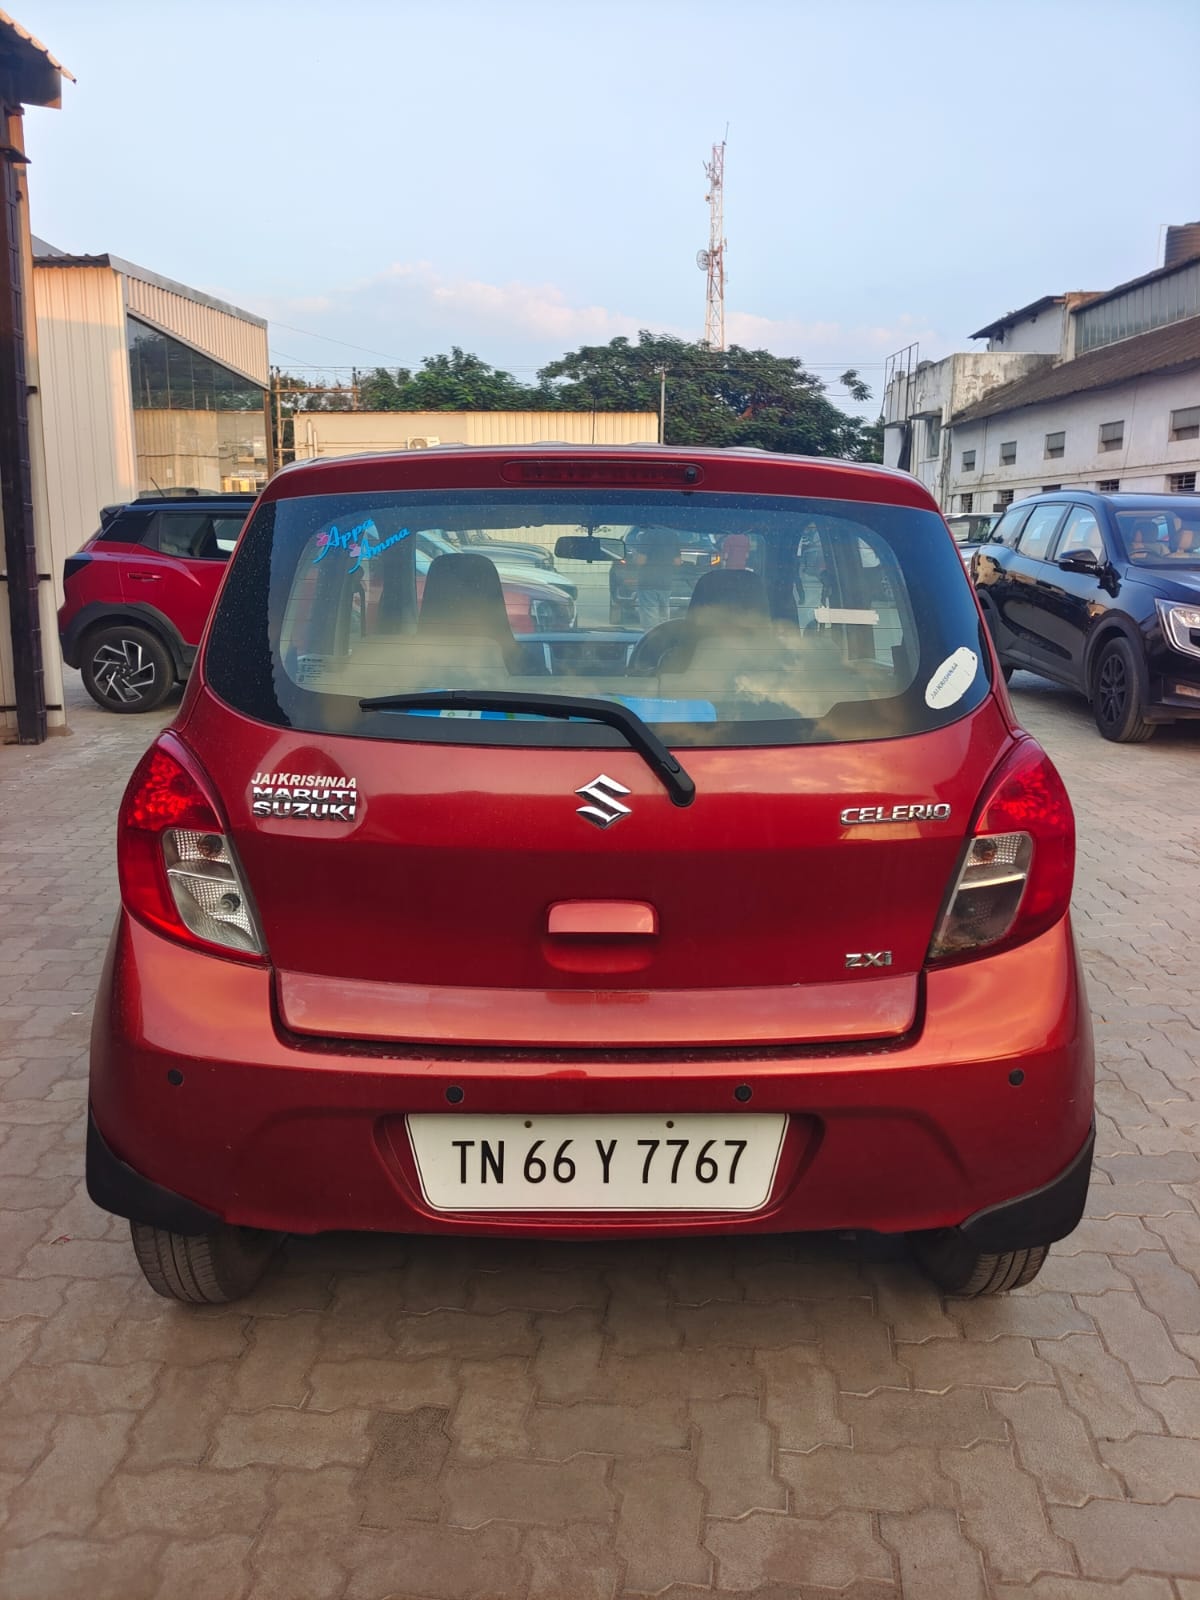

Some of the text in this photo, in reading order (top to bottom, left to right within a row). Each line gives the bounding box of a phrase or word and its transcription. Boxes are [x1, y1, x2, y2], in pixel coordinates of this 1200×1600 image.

[312, 518, 375, 564] Appa
[347, 528, 410, 574] Amma
[252, 786, 357, 802] MARUTI
[252, 801, 356, 821] SUZUKI
[840, 803, 951, 824] CELERIO
[452, 1139, 748, 1184] TN 66 Y 7767
